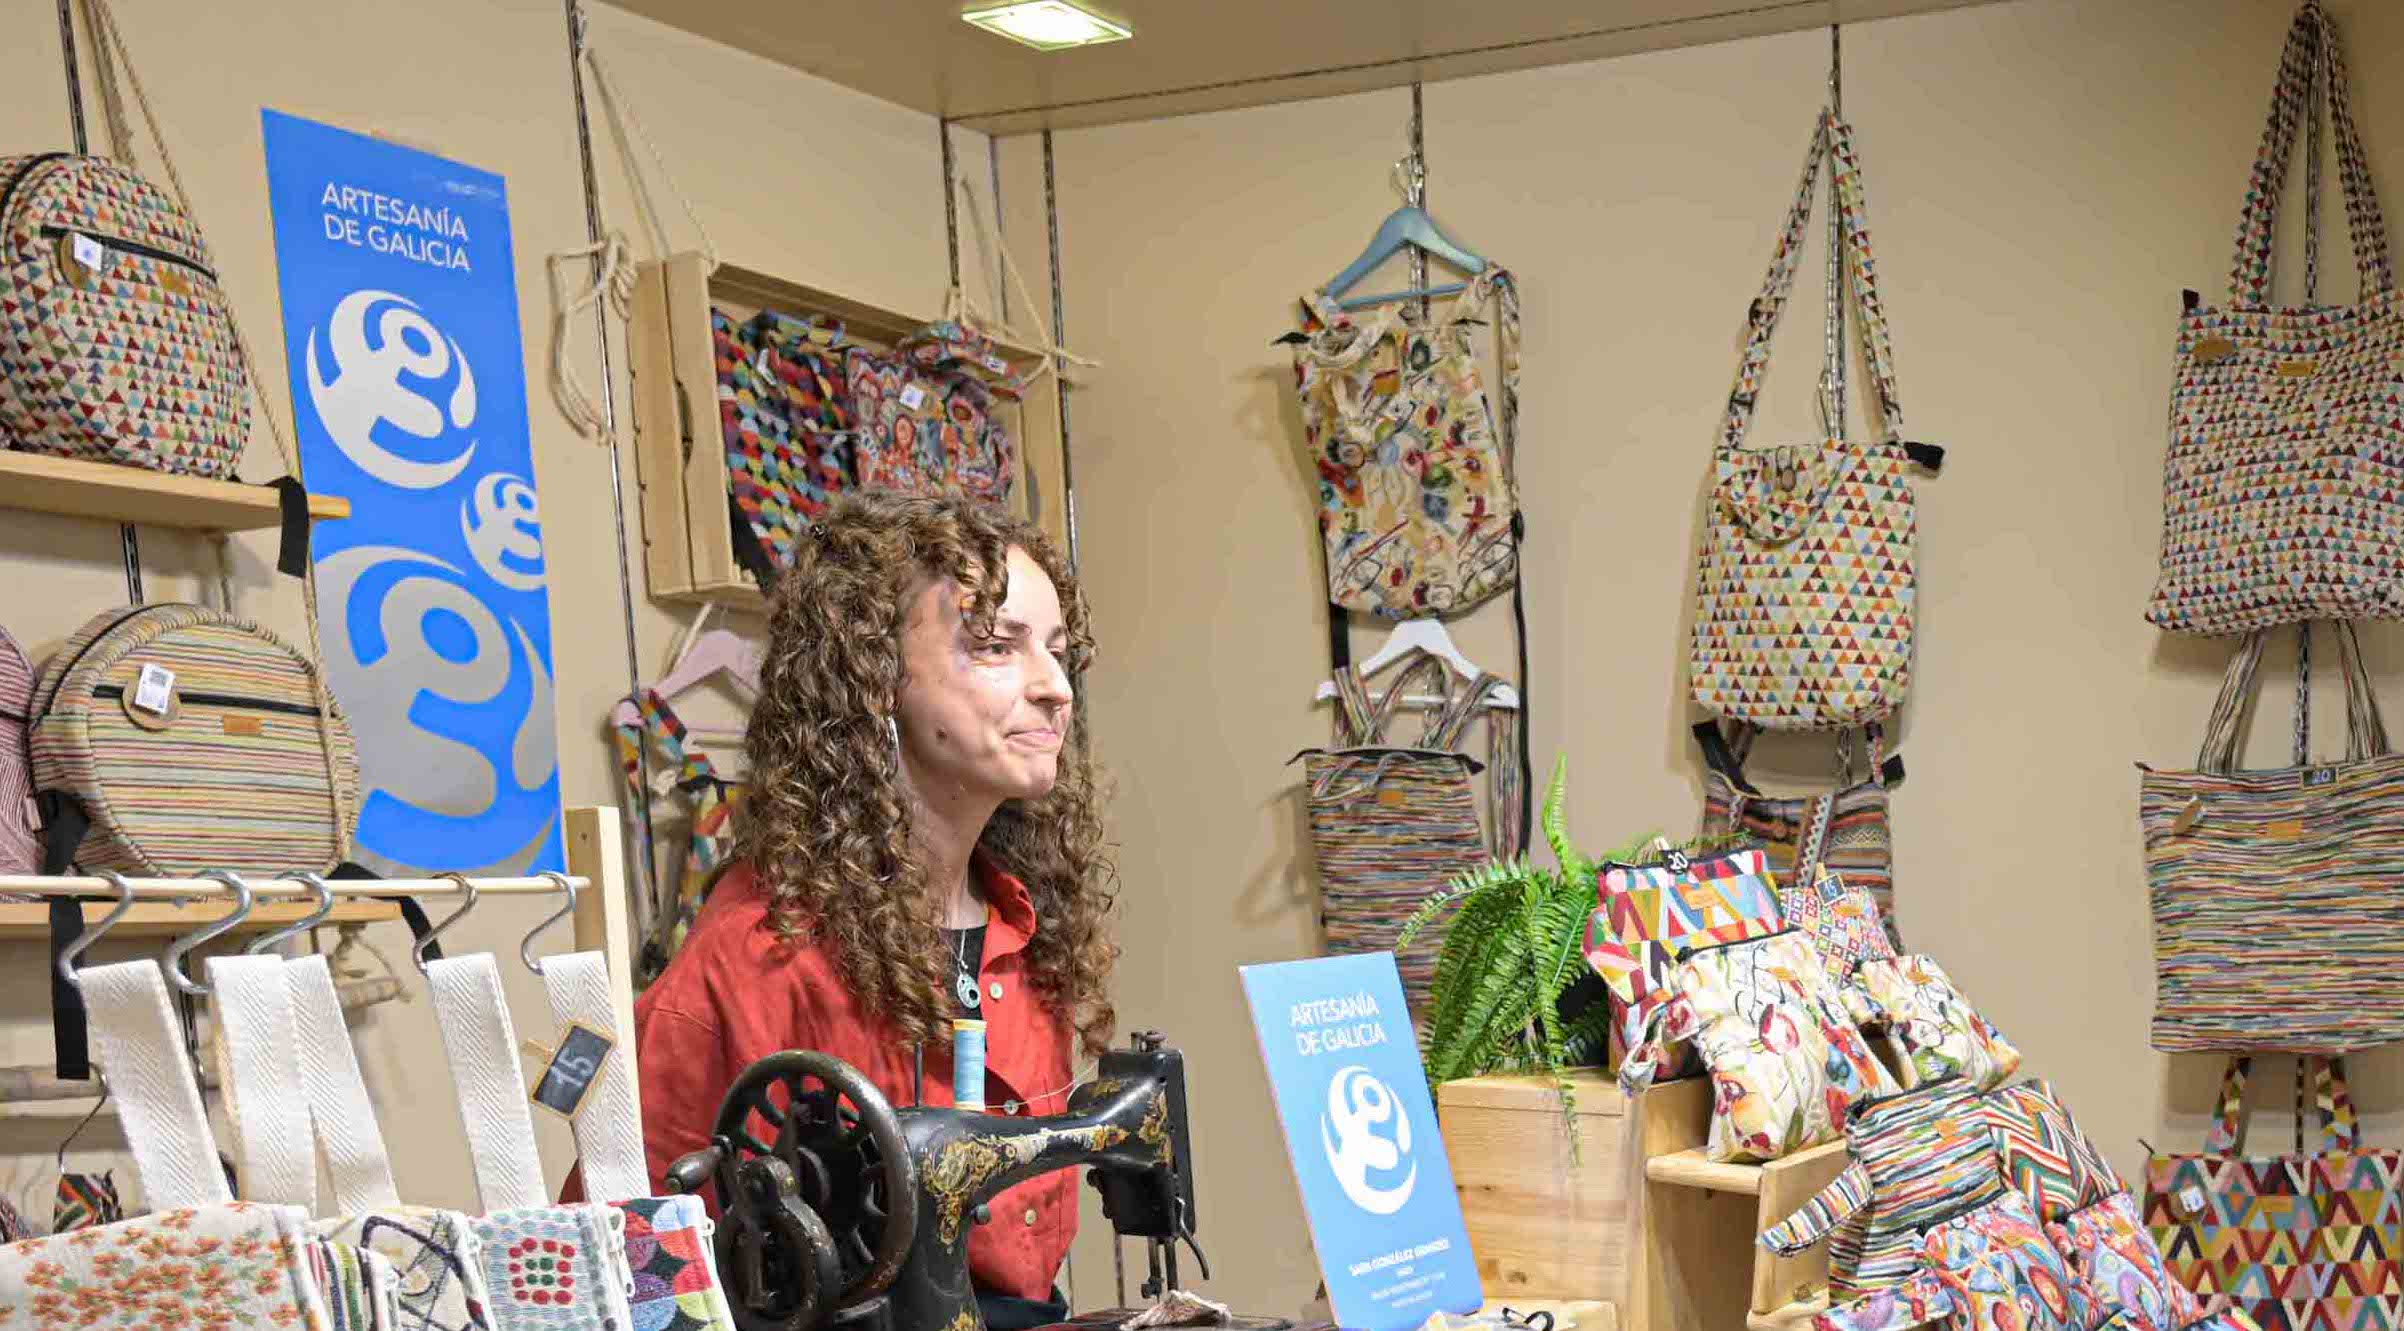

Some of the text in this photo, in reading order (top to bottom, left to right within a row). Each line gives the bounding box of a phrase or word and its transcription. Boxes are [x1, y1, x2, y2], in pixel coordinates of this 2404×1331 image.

[322, 181, 469, 241] ARTESANÍA
[324, 213, 472, 272] DE GALICIA
[1667, 851, 1688, 870] 20
[1288, 991, 1380, 1027] ARTESANÍA
[1296, 1022, 1387, 1056] DE GALICIA
[551, 1047, 595, 1087] 15
